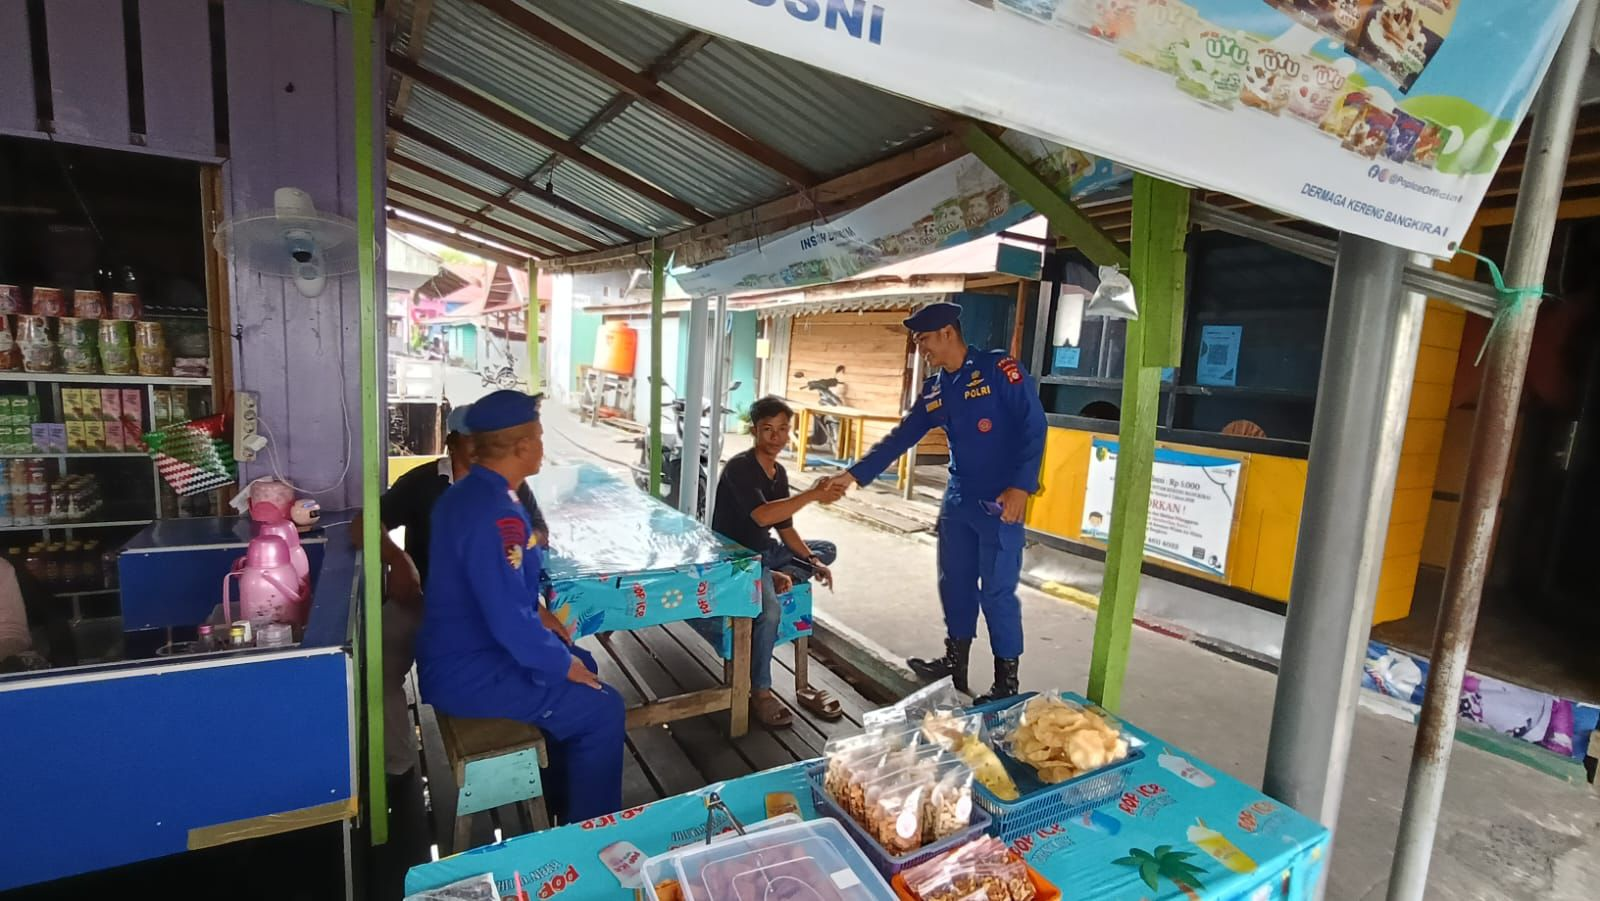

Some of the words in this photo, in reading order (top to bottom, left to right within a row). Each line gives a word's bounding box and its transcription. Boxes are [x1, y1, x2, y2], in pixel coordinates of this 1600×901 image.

[748, 0, 885, 45] SNI
[1206, 36, 1248, 65] UYU
[1264, 52, 1300, 77] UYU
[1316, 67, 1345, 90] UYU
[1300, 183, 1347, 208] DERMAGA
[1348, 199, 1385, 220] KERENG
[1384, 211, 1449, 237] BANGKIRAI
[964, 385, 991, 400] POLRI
[537, 864, 580, 900] POP
